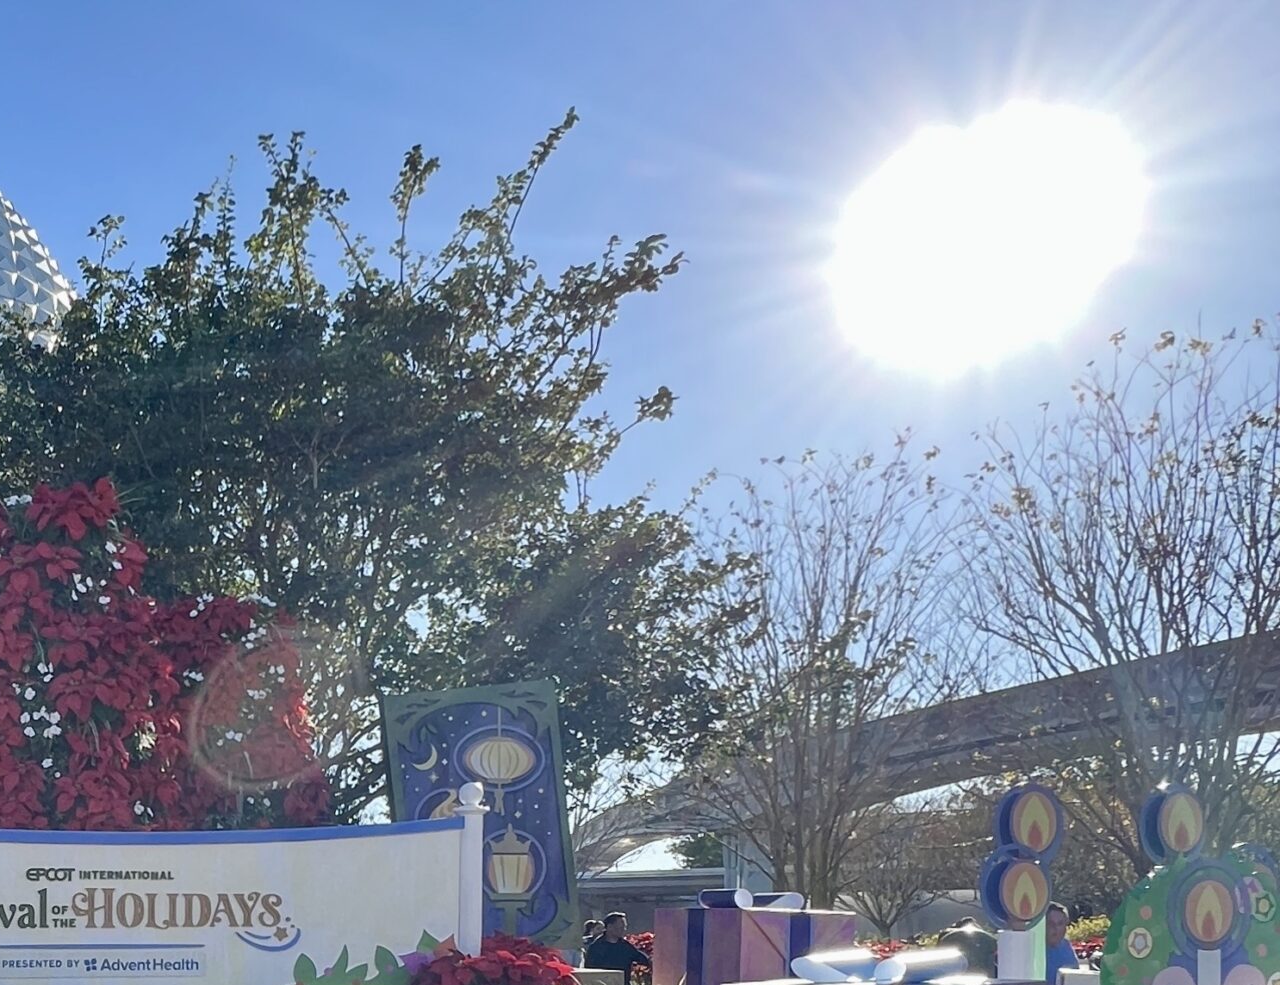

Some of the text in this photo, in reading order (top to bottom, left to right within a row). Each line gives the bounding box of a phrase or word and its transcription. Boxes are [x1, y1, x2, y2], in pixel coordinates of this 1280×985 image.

[26, 868, 174, 881] EPCOT INTERNATIONAL
[52, 905, 68, 915] OF
[71, 888, 283, 929] HOLIDAYS
[52, 918, 76, 928] THE
[1, 958, 199, 971] PRESENTED BY AdventHealth
